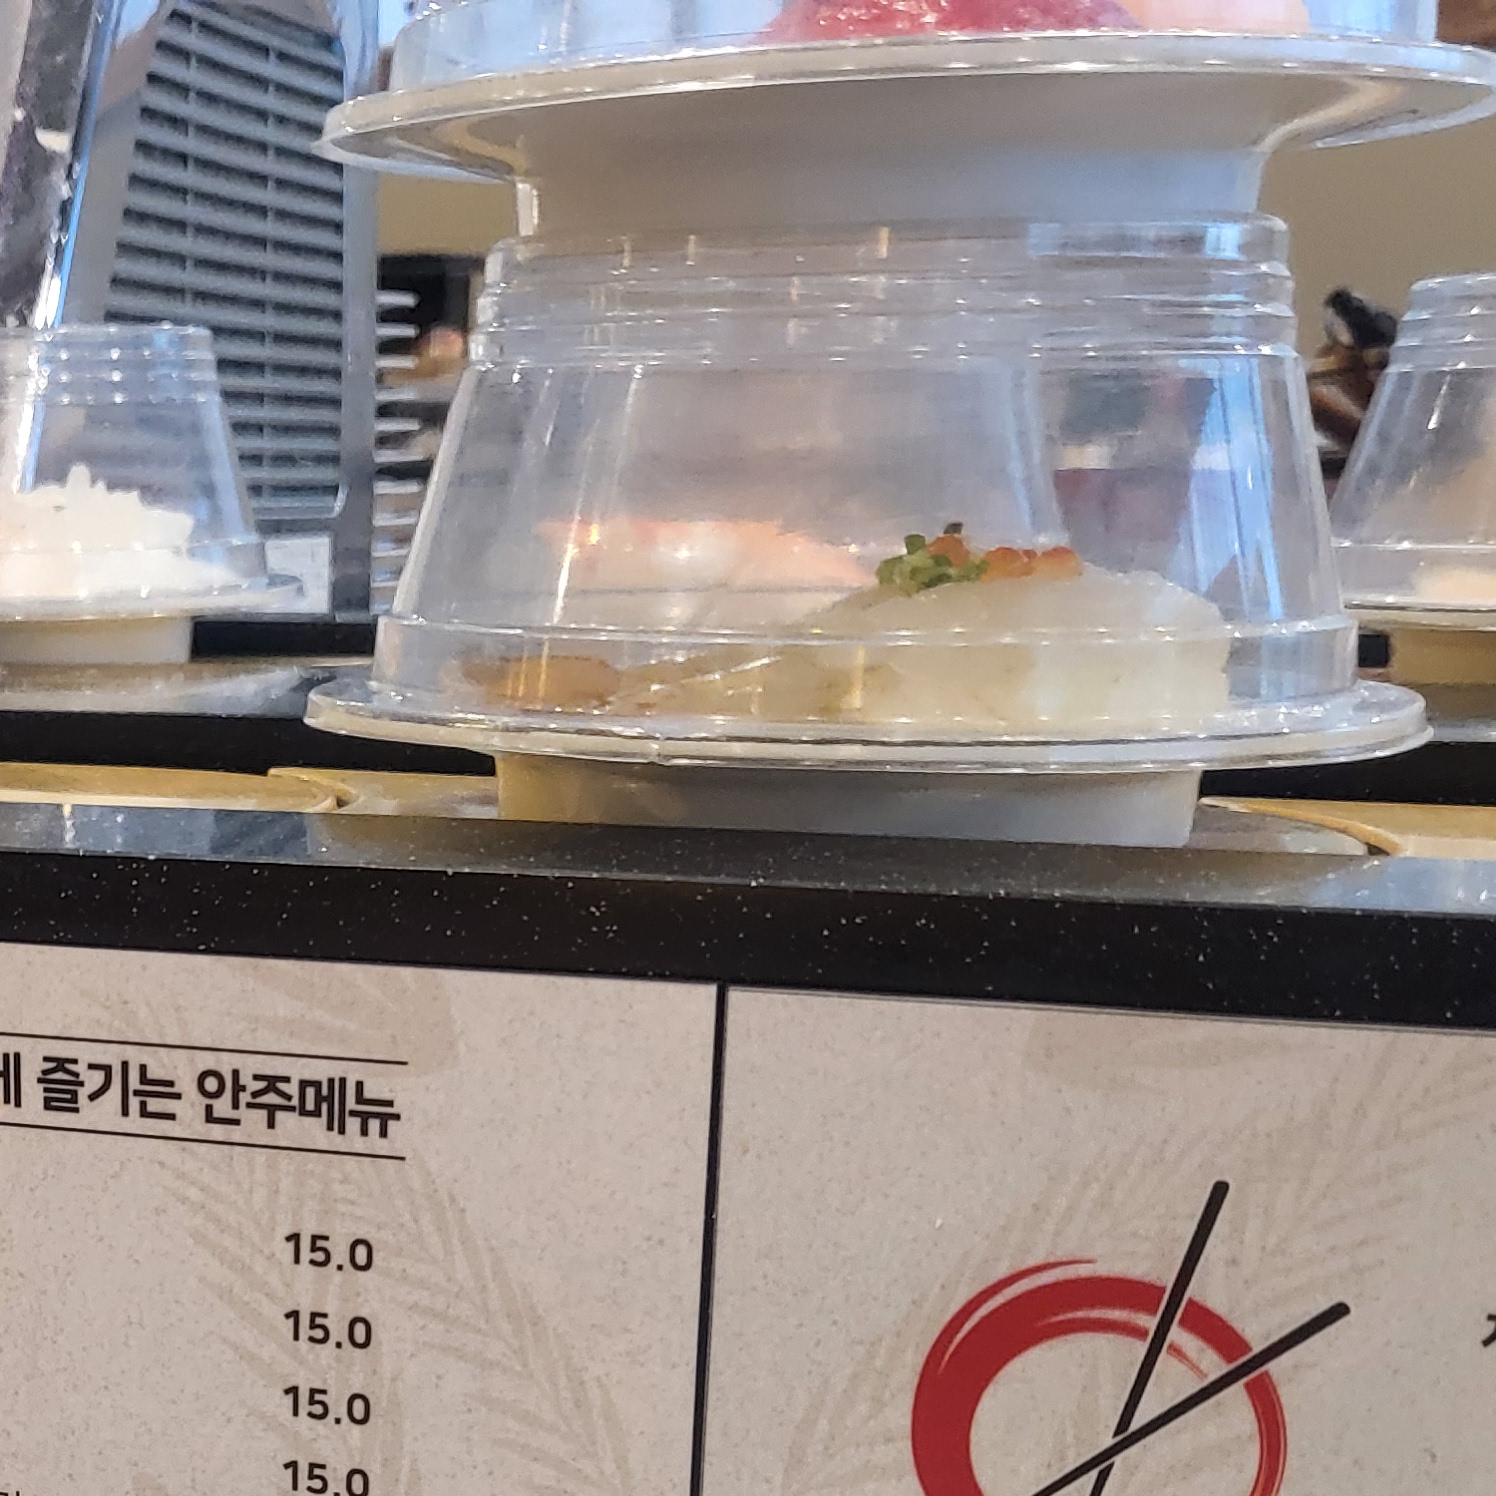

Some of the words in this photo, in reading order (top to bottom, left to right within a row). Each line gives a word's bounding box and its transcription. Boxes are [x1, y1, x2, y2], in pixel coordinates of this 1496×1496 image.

[35, 1054, 184, 1122] 즐기는
[195, 1067, 402, 1140] 안주메뉴
[283, 1231, 374, 1273] 15.0
[283, 1308, 373, 1351] 15.0
[282, 1384, 372, 1427] 15.0
